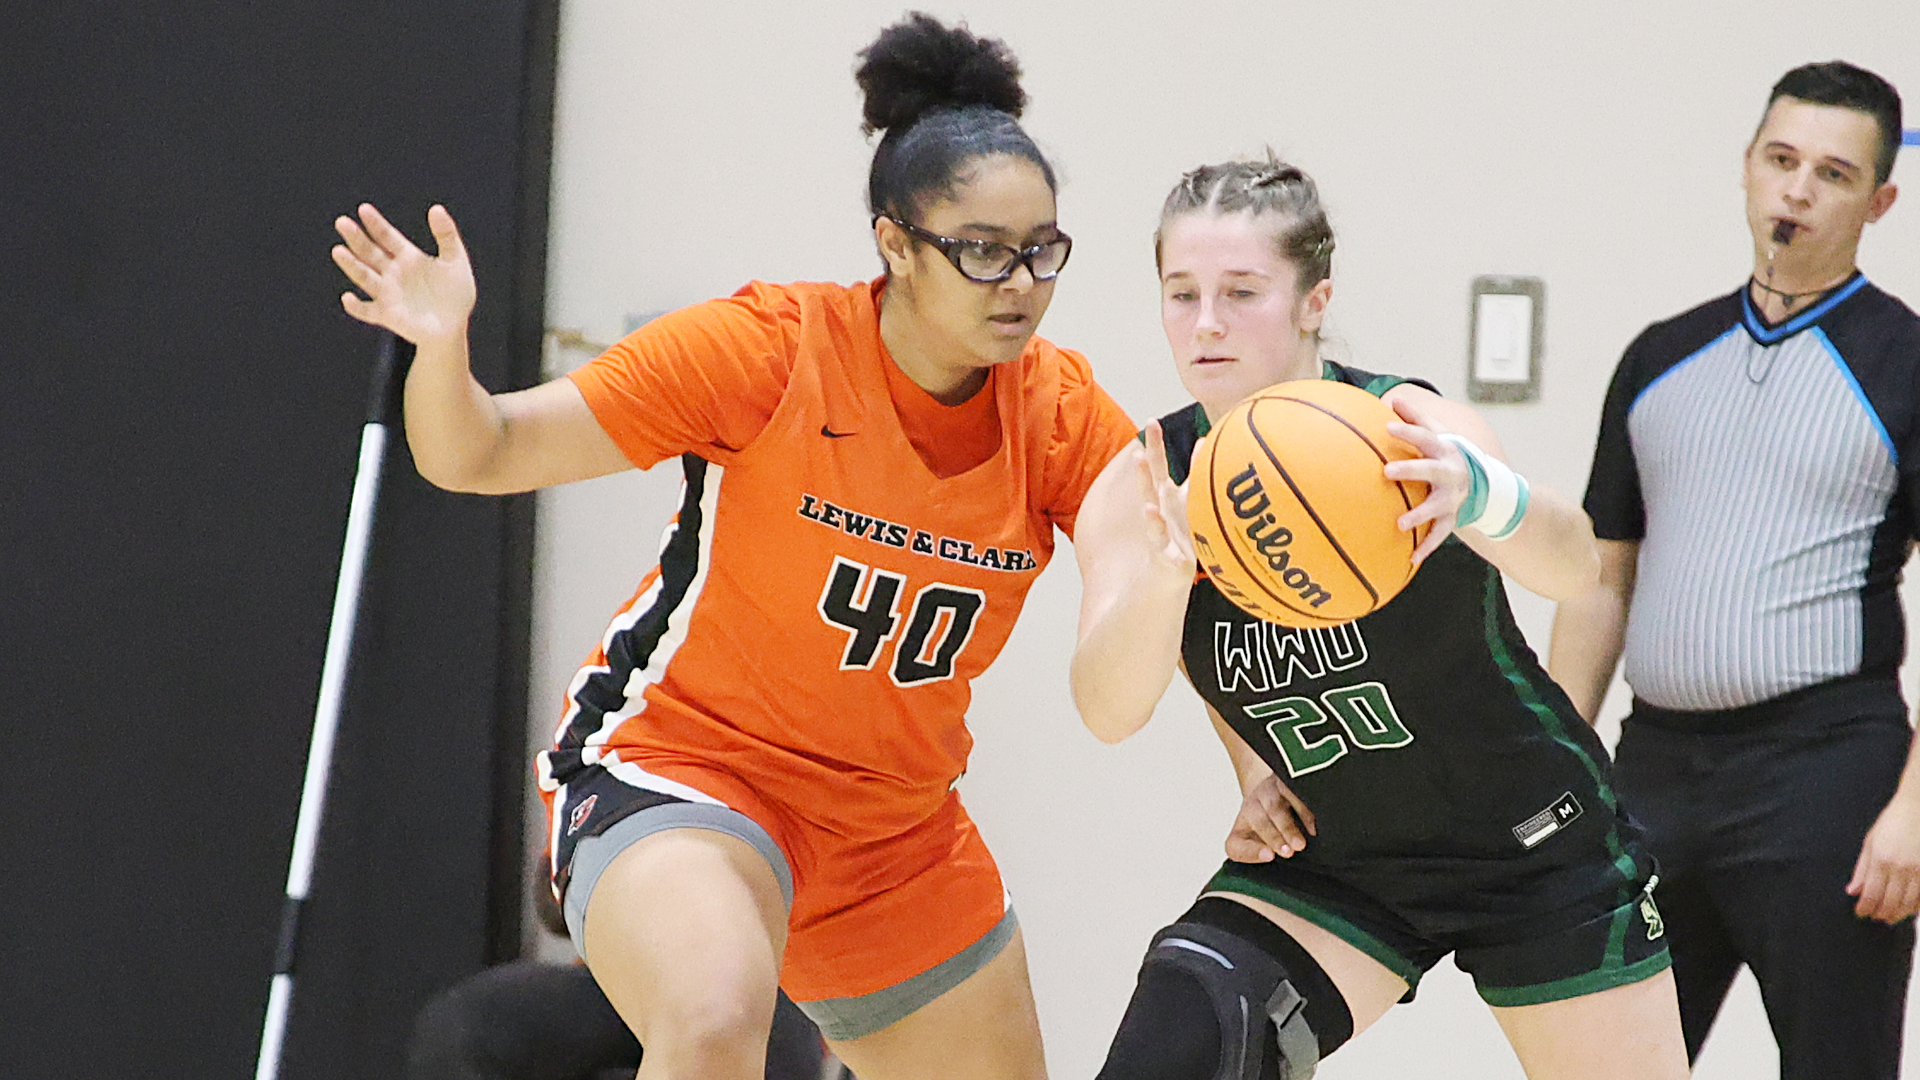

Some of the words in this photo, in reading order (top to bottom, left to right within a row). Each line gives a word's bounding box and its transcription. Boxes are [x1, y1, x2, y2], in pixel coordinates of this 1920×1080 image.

[798, 493, 910, 549] LEWIS
[911, 528, 935, 555] &
[1226, 461, 1333, 608] Wilson
[817, 555, 987, 688] 40
[1242, 681, 1415, 779] 20
[1558, 802, 1575, 819] M
